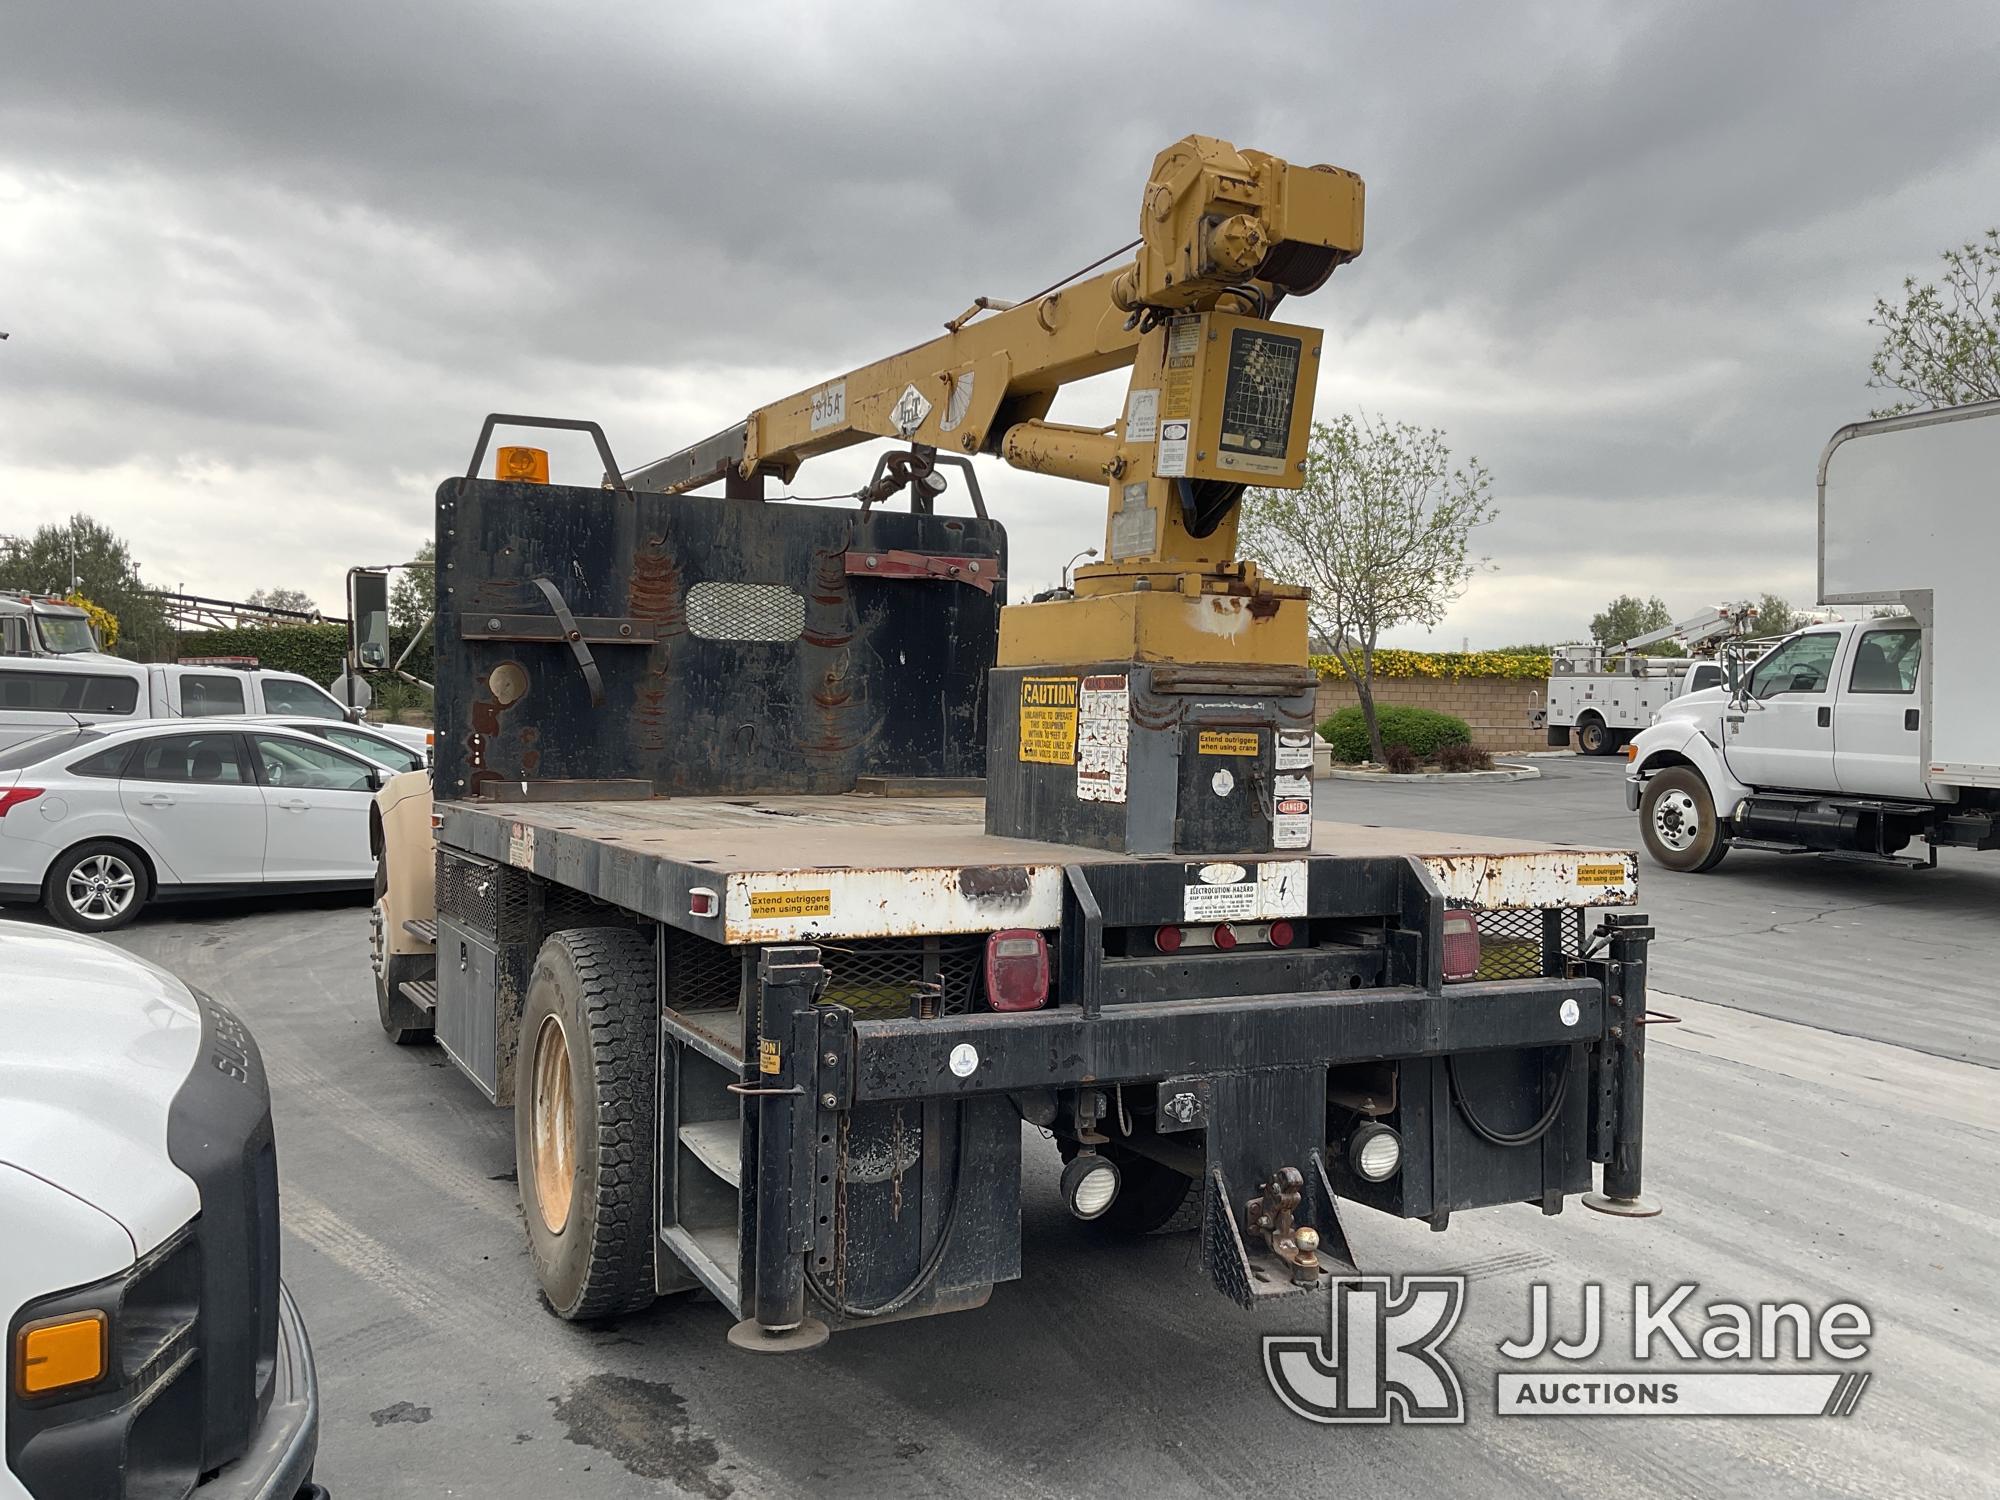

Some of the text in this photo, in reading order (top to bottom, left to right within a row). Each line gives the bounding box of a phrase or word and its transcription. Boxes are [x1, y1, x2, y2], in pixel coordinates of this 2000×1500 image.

[1024, 684, 1075, 705] CAUTION
[1055, 712, 1072, 720] OPERATE
[1062, 732, 1068, 740] OF
[1225, 736, 1257, 745] outriggers
[1053, 740, 1064, 749] LINES
[1220, 744, 1236, 752] using
[1052, 750, 1058, 759] OR
[1060, 751, 1070, 760] LESS
[1190, 886, 1230, 895] ELECTROCUTION
[752, 895, 829, 904] Extend outriggers
